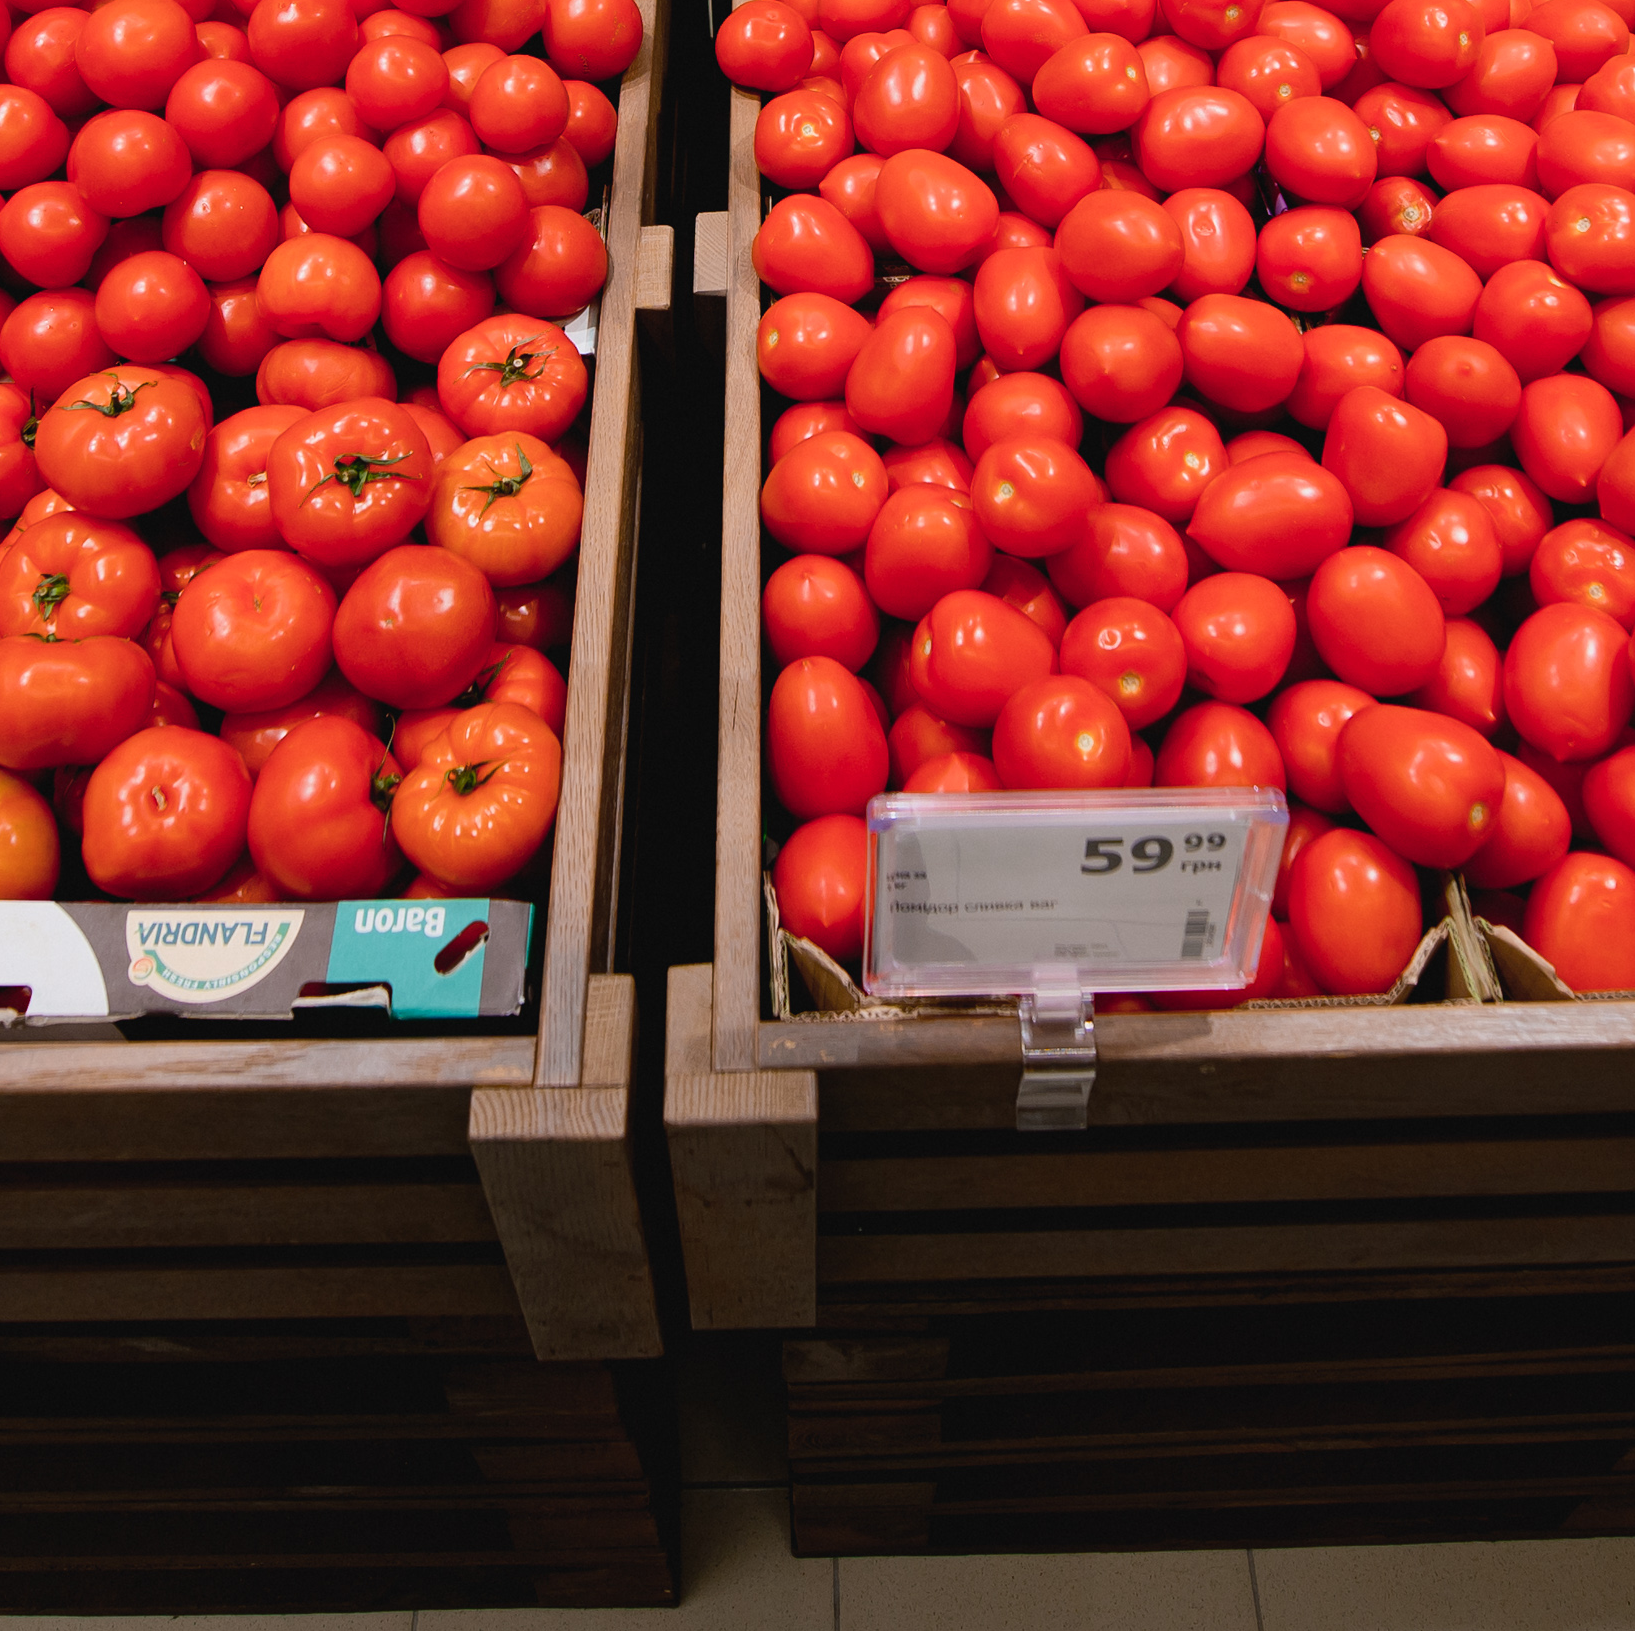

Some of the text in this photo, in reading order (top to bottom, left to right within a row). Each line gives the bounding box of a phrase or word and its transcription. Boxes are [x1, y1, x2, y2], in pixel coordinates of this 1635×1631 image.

[1080, 835, 1174, 876] 59
[134, 922, 270, 946] FLANDRIA
[352, 905, 445, 938] Baron
[161, 968, 199, 990] FRESH
